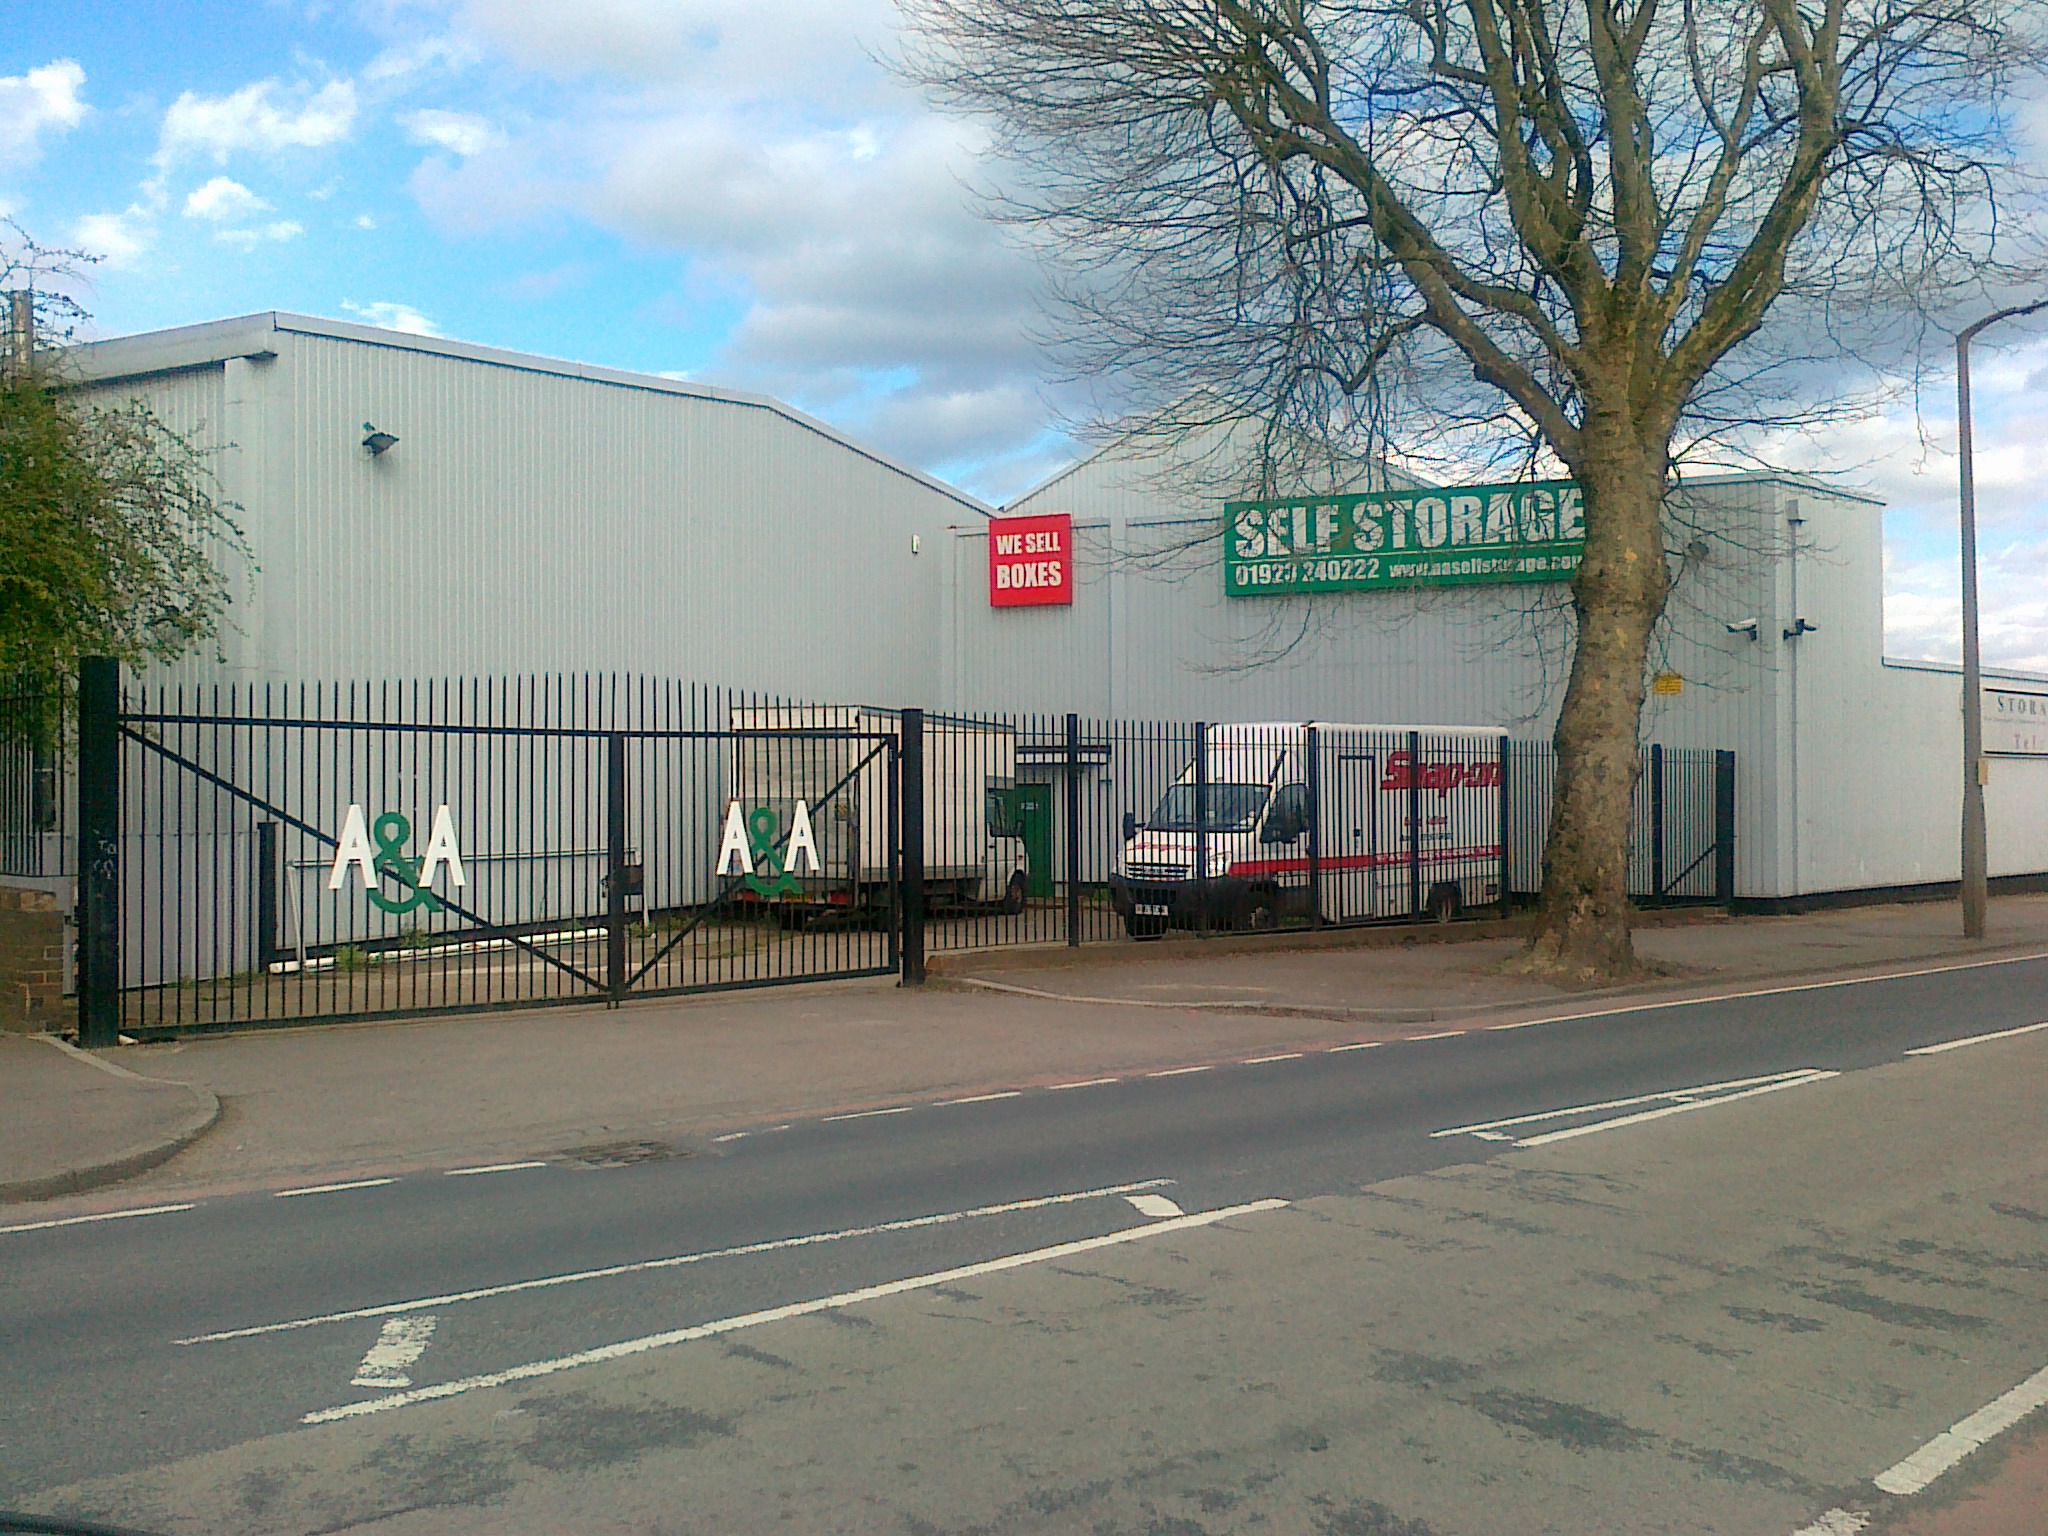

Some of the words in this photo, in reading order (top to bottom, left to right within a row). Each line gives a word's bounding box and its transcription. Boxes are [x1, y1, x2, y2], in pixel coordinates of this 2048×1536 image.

[996, 534, 1022, 555] WE
[1025, 531, 1061, 553] SELL
[1235, 504, 1339, 558] SELF
[1352, 488, 1586, 552] STORAGE
[996, 561, 1062, 589] BOXES
[1302, 558, 1380, 582] 240222
[328, 804, 467, 914] A&A
[716, 800, 820, 896] A&A
